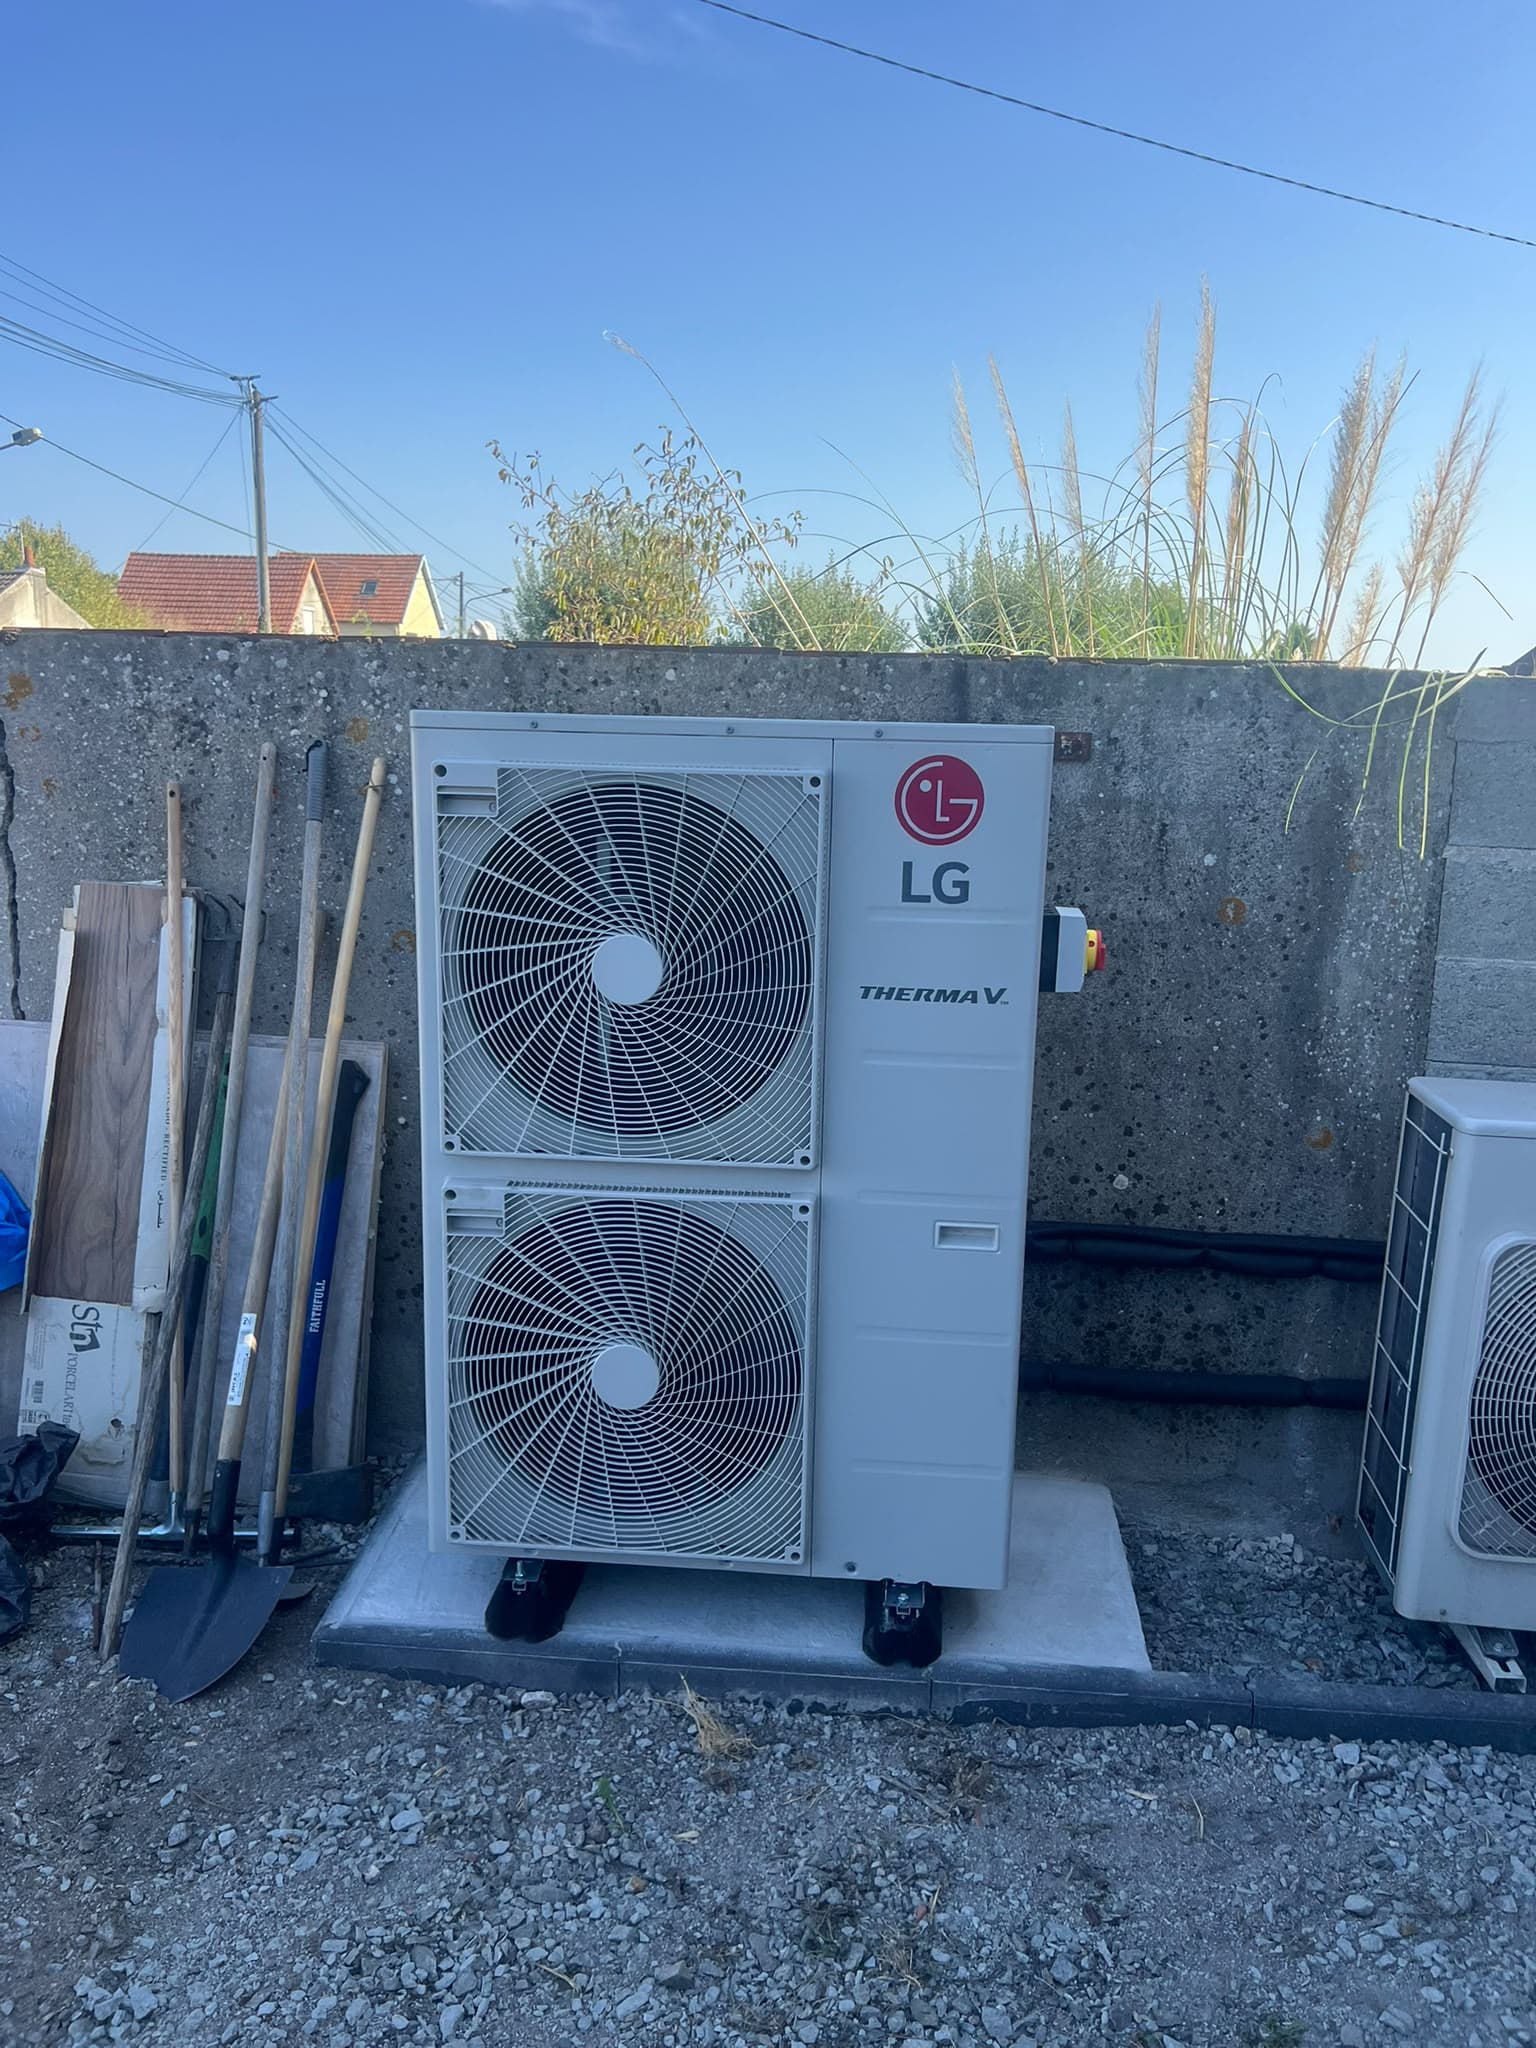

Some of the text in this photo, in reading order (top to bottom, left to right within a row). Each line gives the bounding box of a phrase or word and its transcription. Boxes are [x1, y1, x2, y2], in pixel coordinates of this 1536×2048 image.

[901, 860, 970, 905] LG
[859, 985, 978, 1004] THERMA
[309, 1279, 326, 1333] FAITHFULL
